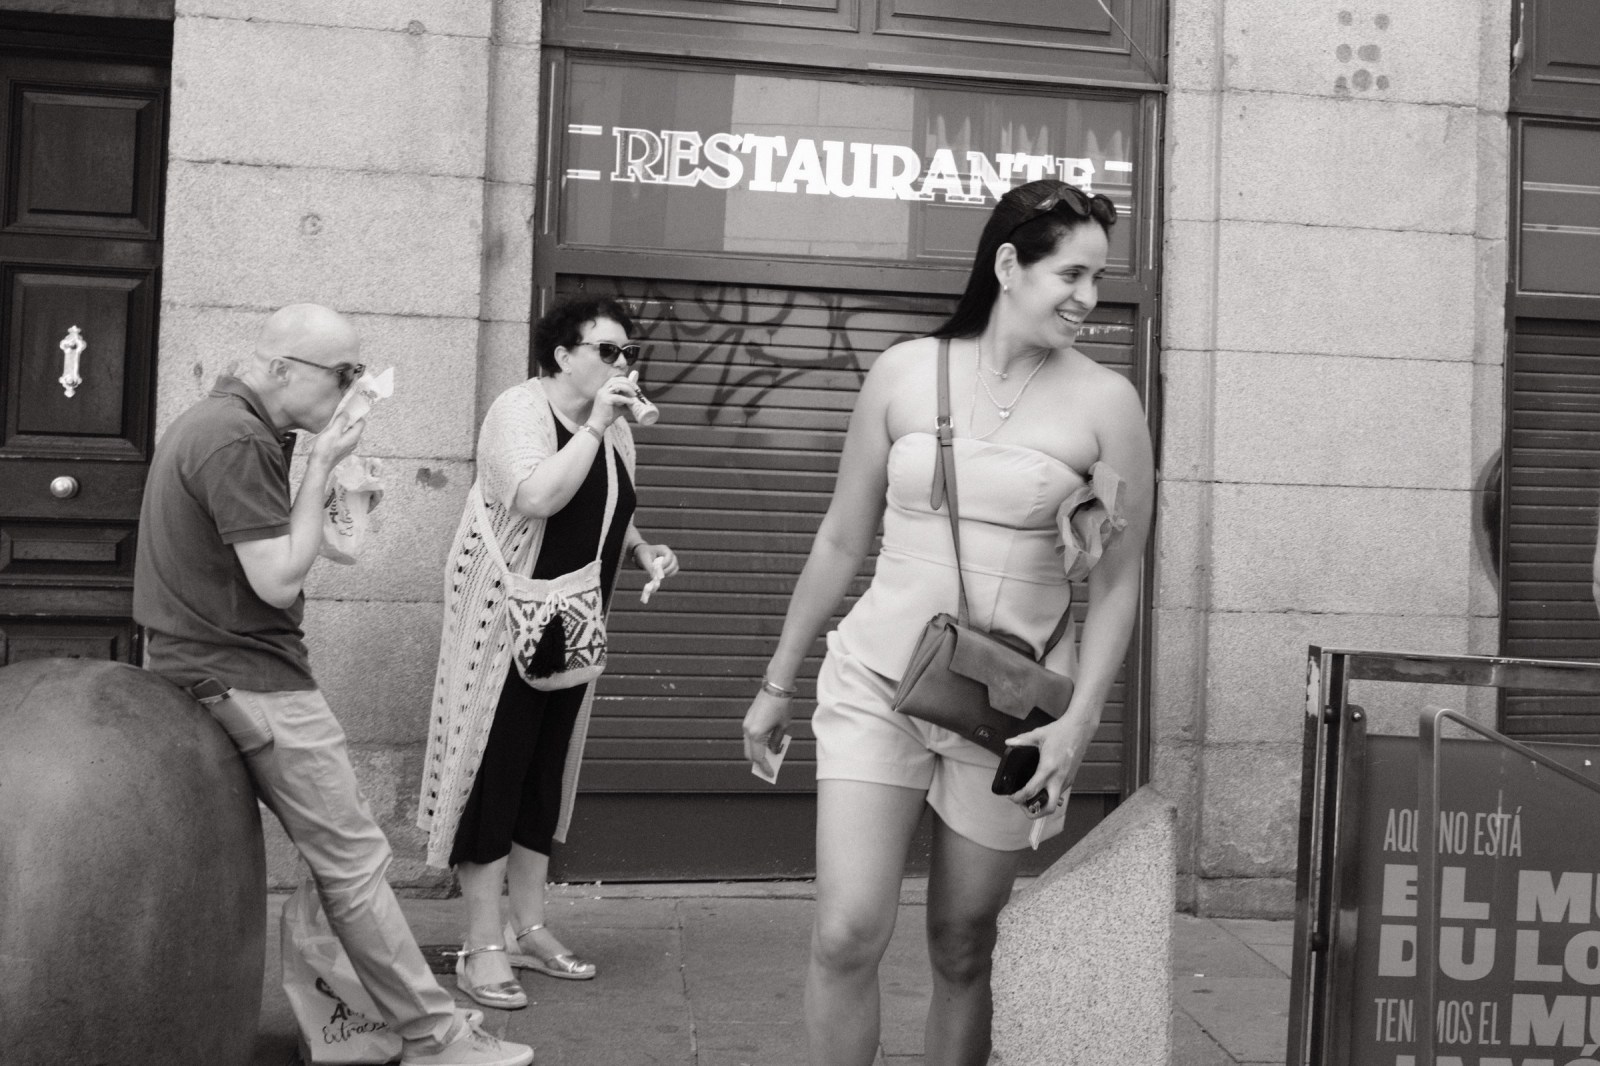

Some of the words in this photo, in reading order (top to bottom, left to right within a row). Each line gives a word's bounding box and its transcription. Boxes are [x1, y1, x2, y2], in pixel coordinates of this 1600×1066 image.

[1438, 811, 1469, 855] NO
[1473, 806, 1523, 857] ESTÁ
[1382, 863, 1490, 920] EL
[1516, 869, 1600, 924] M
[1378, 924, 1497, 981] DU
[1478, 1001, 1502, 1045] EL
[1509, 993, 1600, 1048] M
